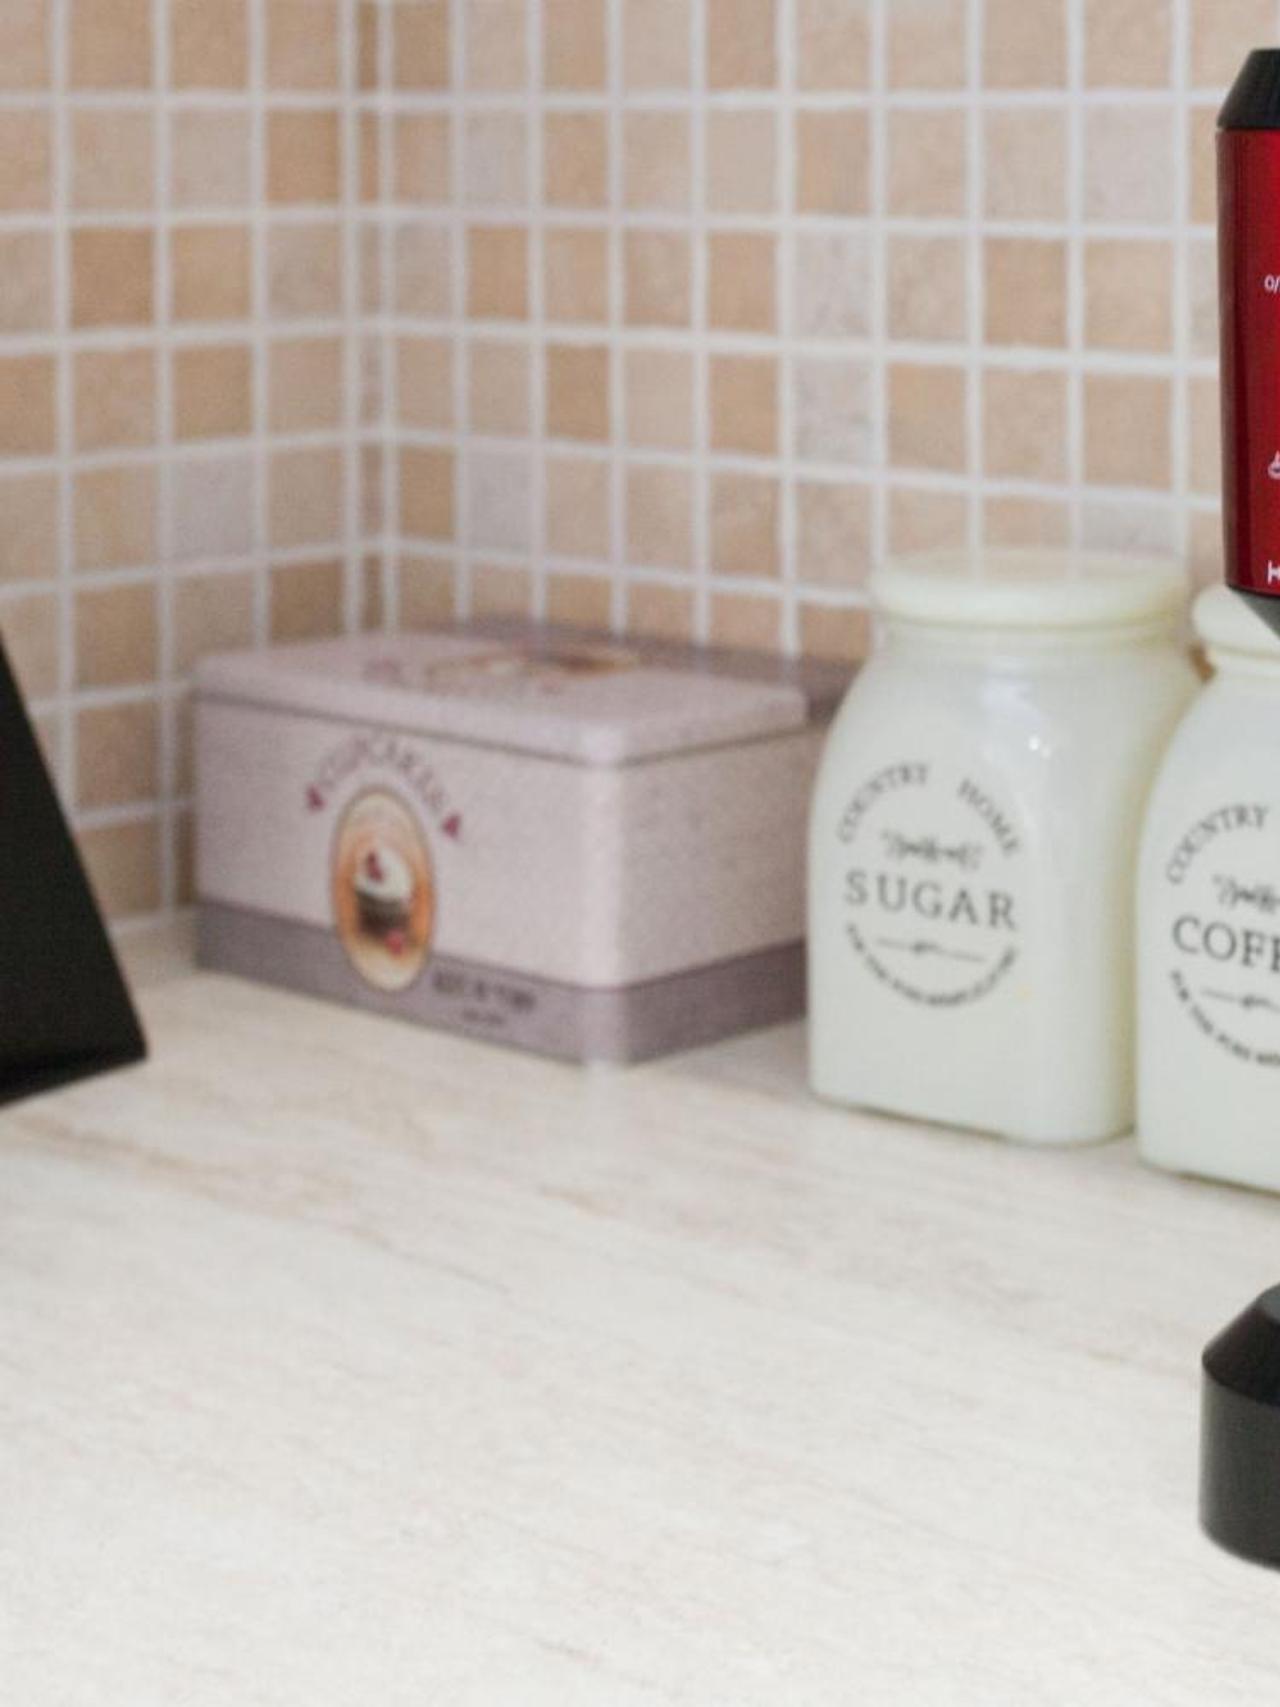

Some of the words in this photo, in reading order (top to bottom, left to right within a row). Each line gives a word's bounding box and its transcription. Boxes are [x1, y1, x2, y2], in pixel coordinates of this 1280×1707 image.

[836, 762, 928, 844] COUNTRY
[957, 778, 1020, 855] HOME
[1165, 803, 1269, 885] COUNTRY
[845, 868, 1018, 931] SUGAR
